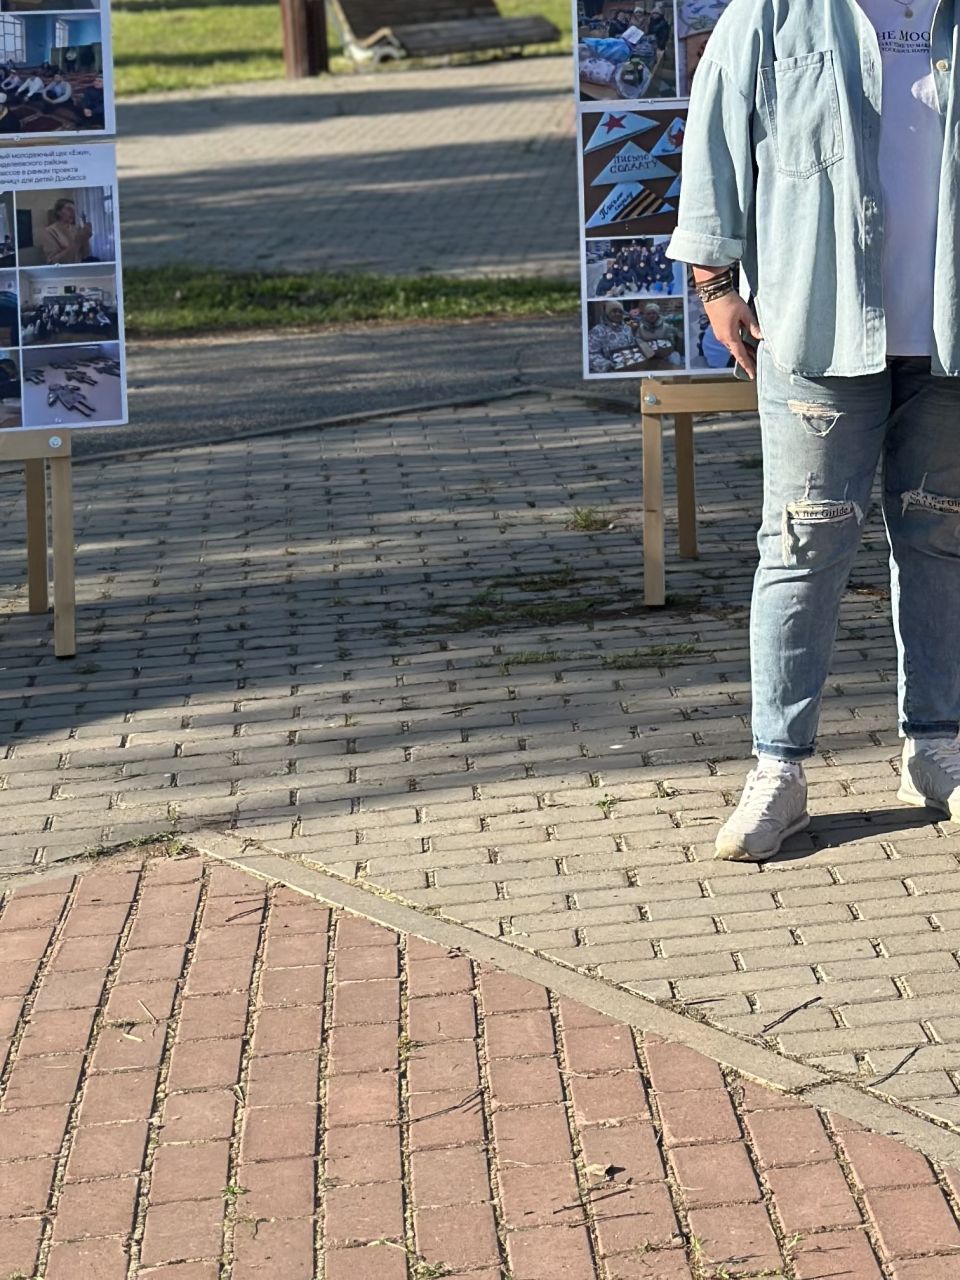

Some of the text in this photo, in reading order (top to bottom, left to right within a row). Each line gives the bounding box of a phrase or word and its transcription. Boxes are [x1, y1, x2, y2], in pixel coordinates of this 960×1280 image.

[877, 30, 930, 42] HE MOO
[51, 167, 79, 175] проекта
[55, 174, 87, 183] Донбасса
